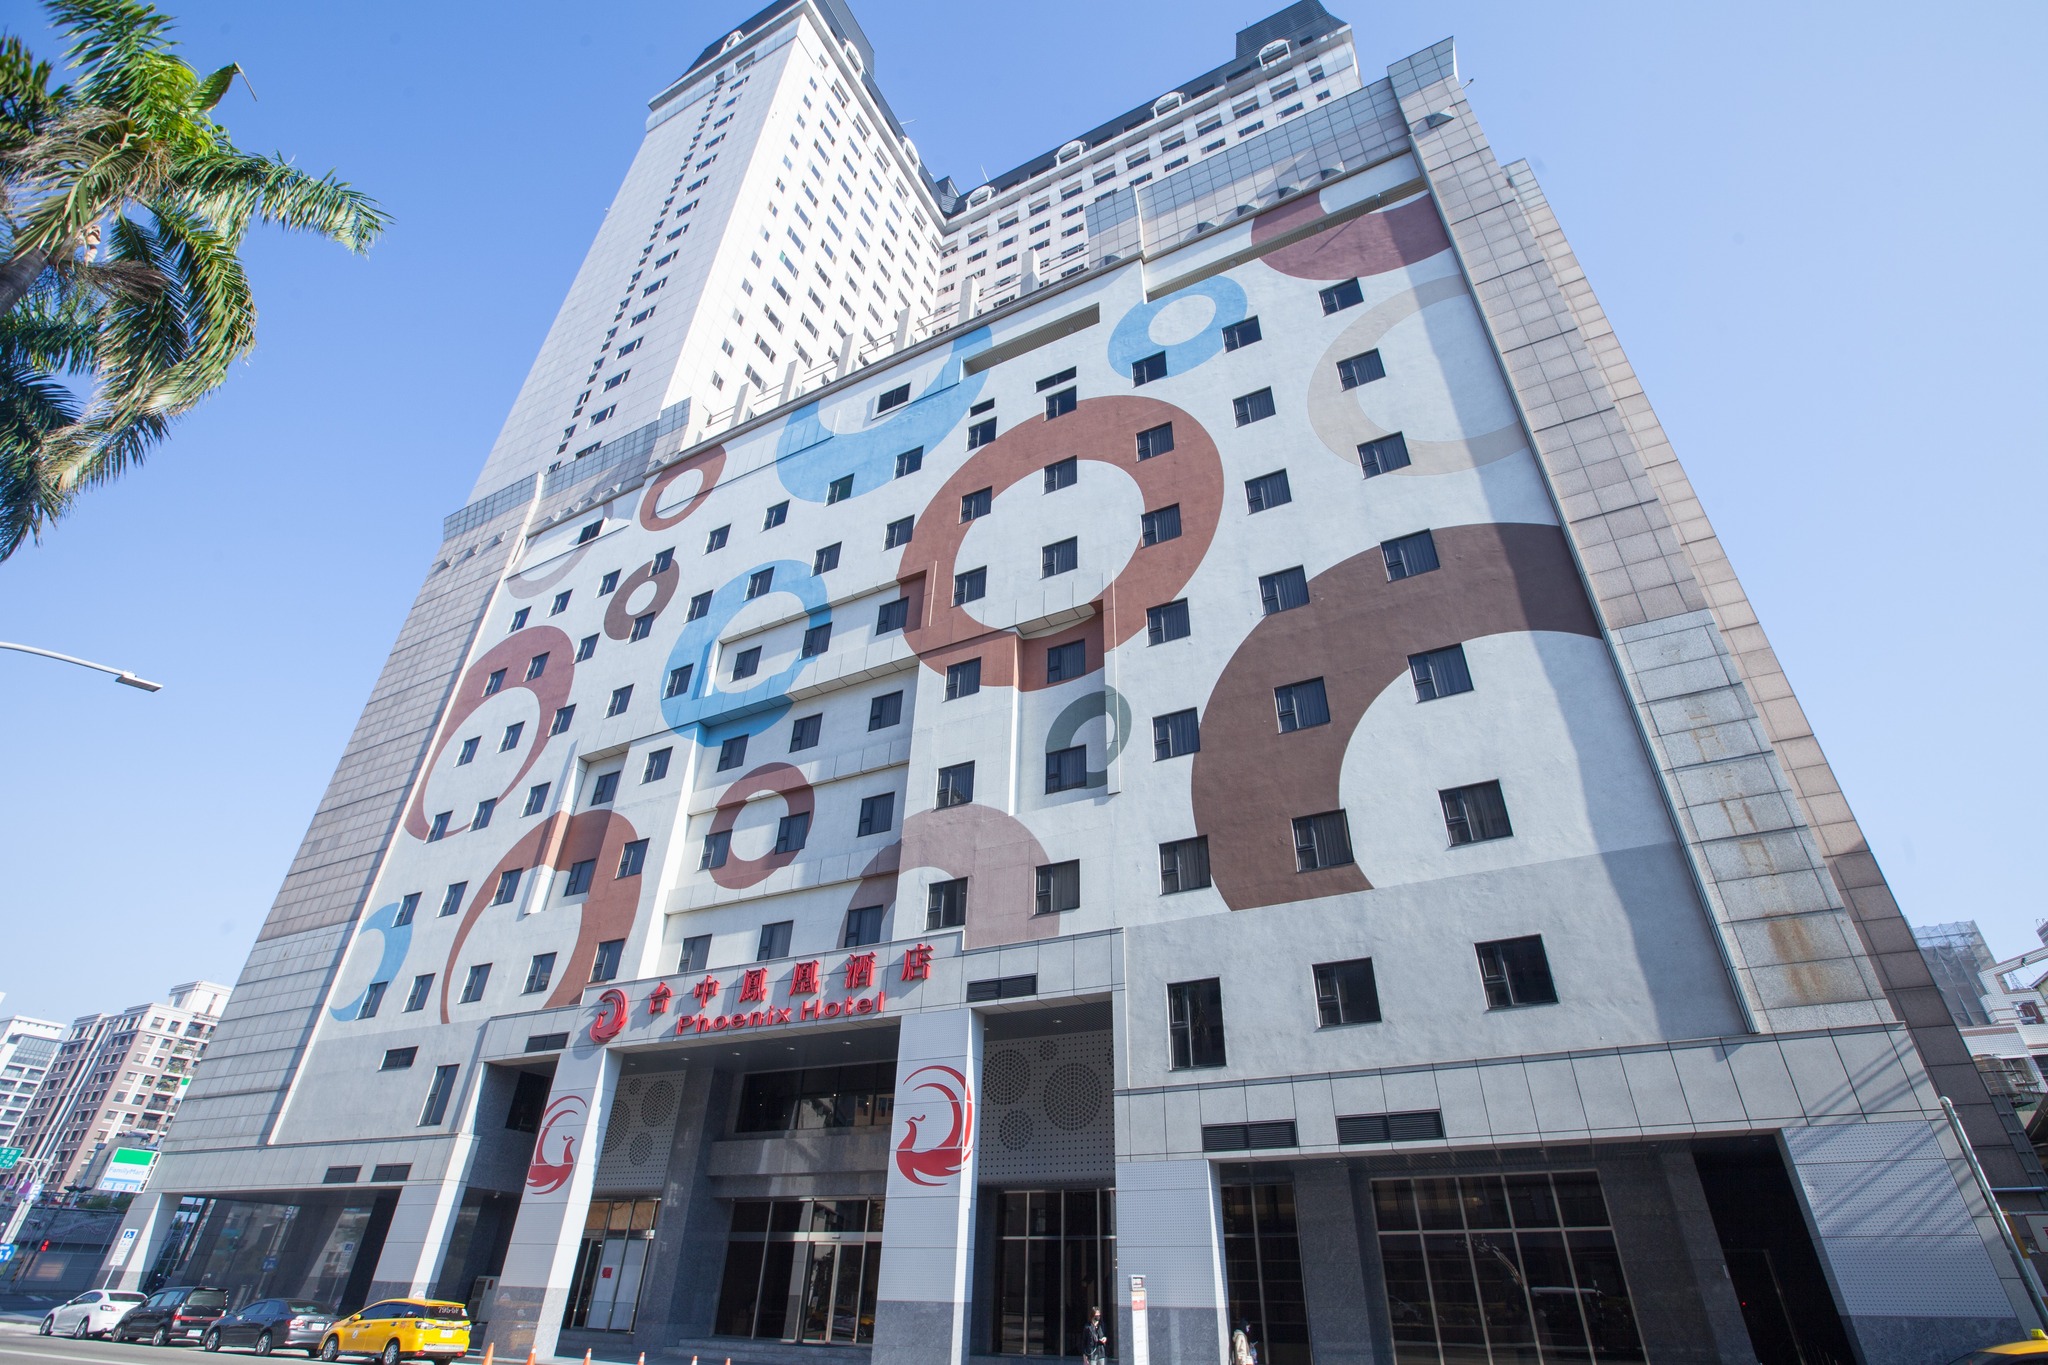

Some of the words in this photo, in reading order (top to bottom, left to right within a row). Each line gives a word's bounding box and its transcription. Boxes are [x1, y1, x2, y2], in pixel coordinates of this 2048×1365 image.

[647, 943, 934, 1015] 台中鳳凰酒店
[675, 1005, 793, 1036] Phoenix
[800, 991, 887, 1021] Hotel
